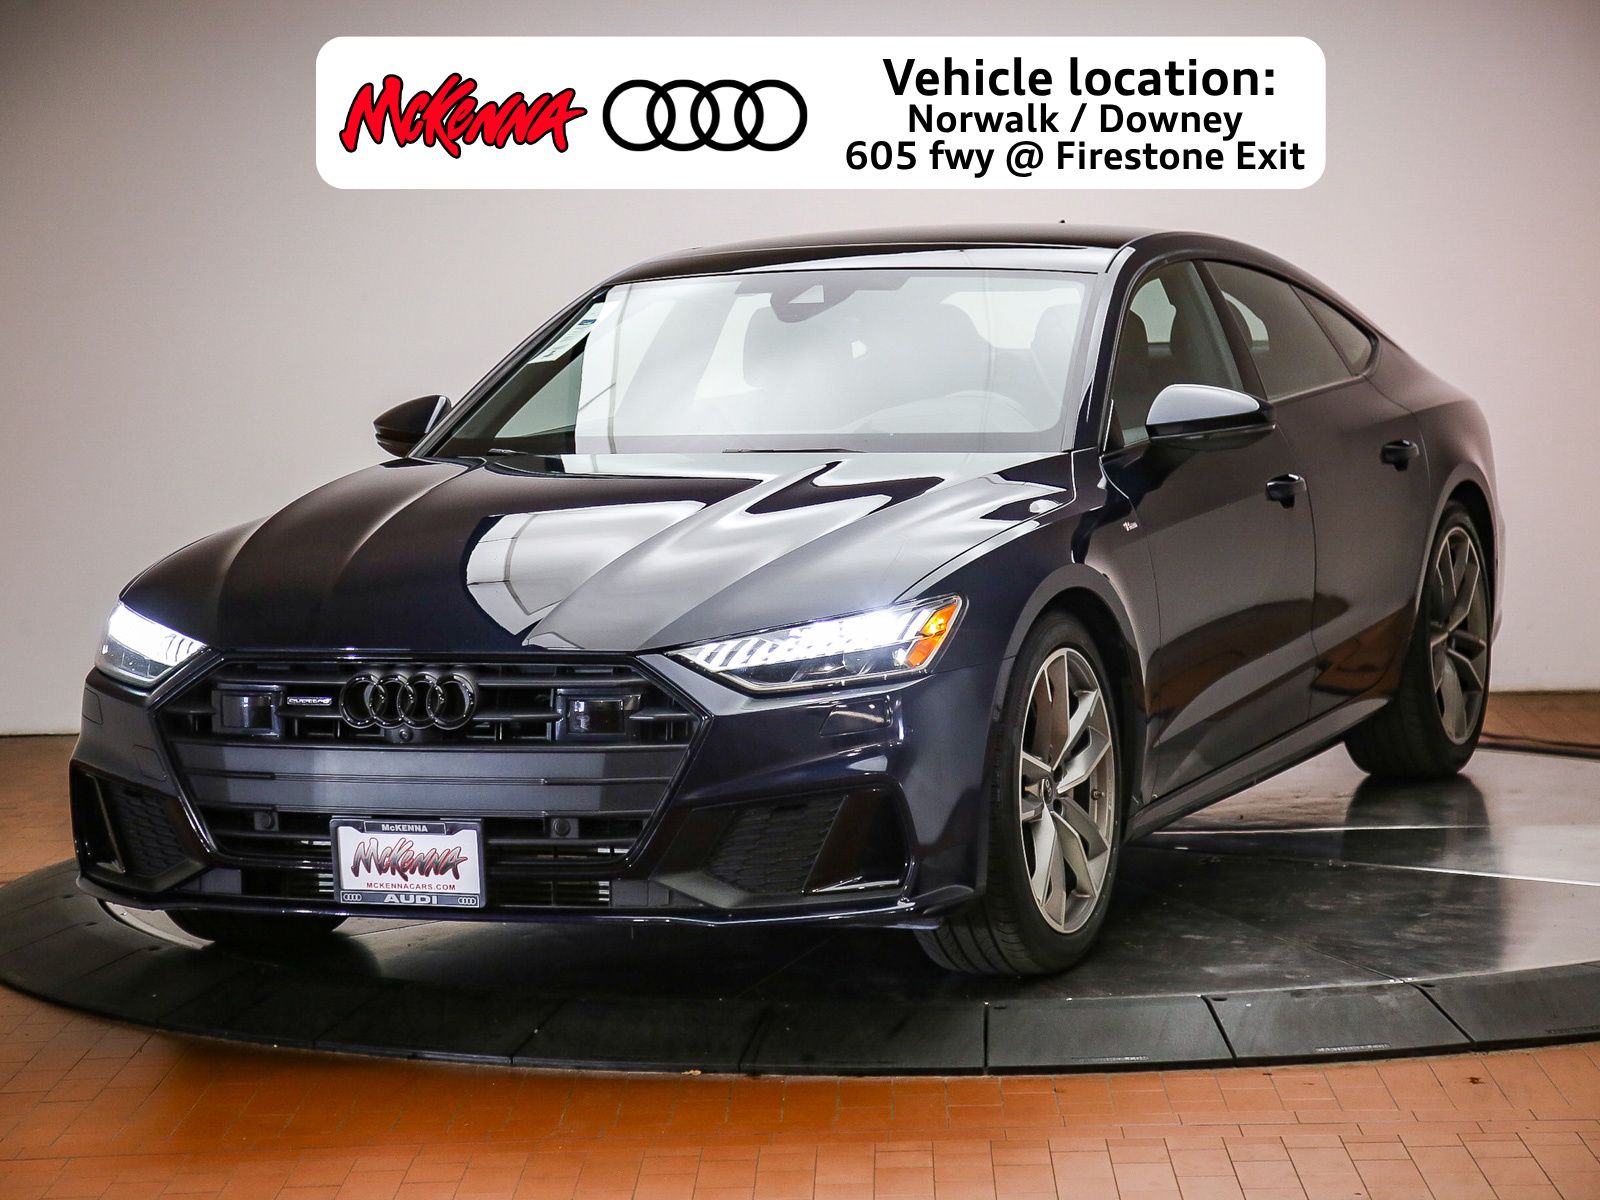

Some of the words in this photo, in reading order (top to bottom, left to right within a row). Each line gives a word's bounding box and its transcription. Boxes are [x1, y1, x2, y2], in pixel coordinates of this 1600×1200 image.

[381, 823, 428, 833] McKENNA
[366, 882, 456, 891] MCKENNACARS.COM
[383, 893, 438, 905] AUDI
